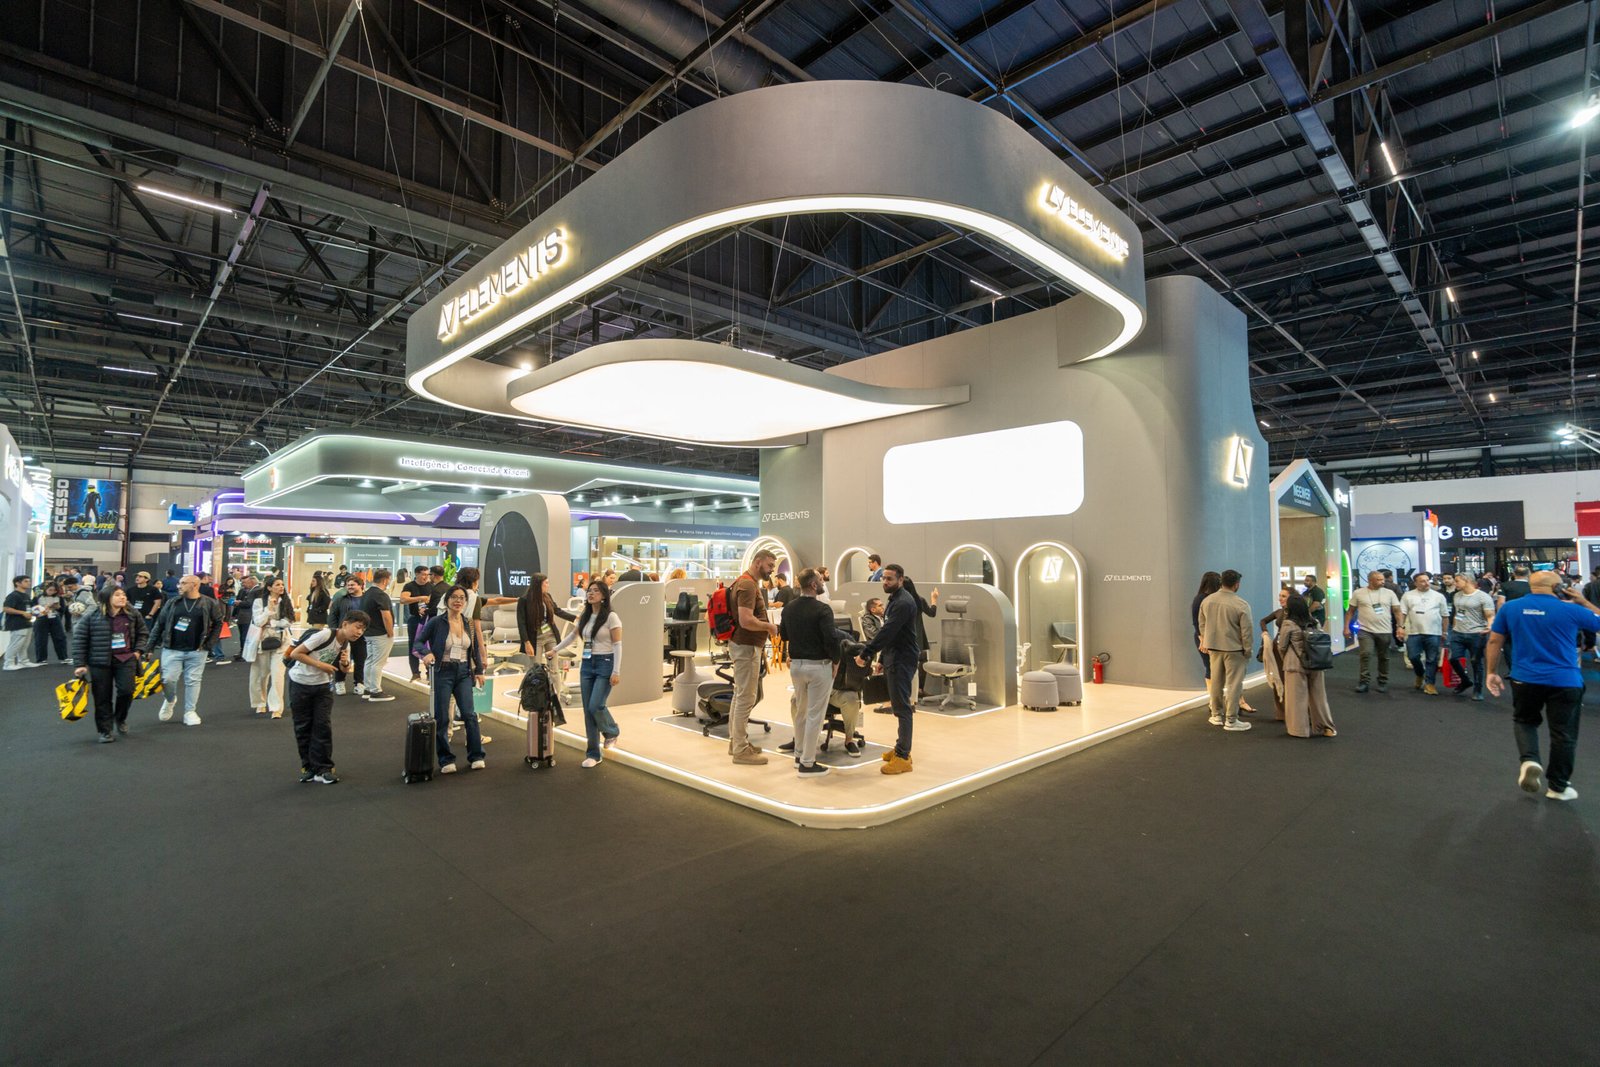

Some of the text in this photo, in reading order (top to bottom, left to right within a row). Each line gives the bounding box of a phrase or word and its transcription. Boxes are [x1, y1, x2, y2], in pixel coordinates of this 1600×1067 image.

[458, 227, 566, 322] ELEMENTS
[54, 479, 70, 533] ACESSO
[771, 511, 810, 521] ELEMENTS
[1461, 525, 1498, 537] Boali
